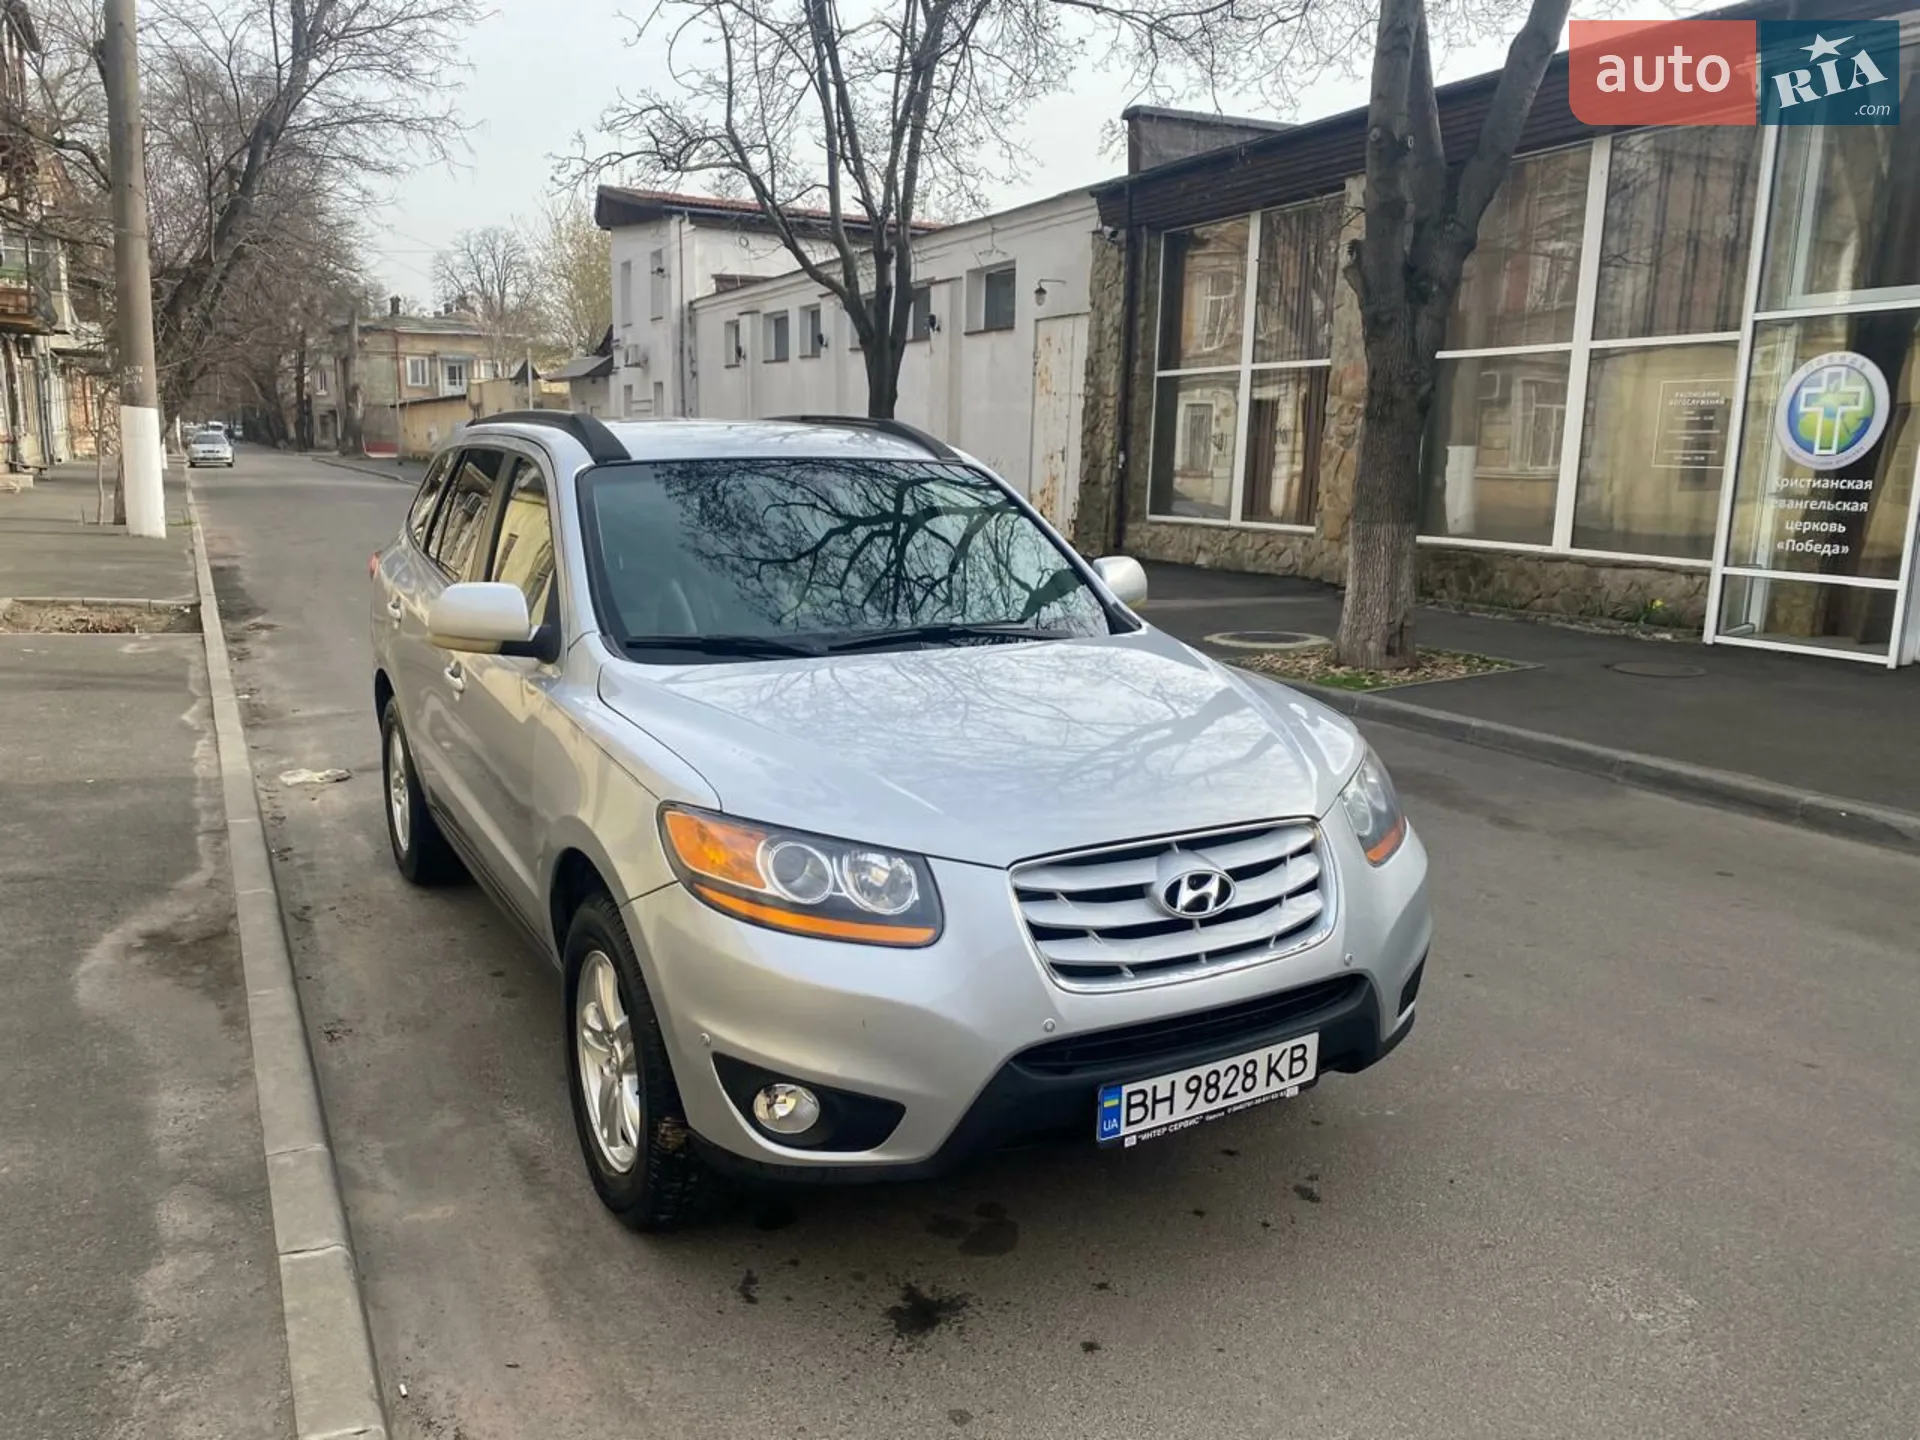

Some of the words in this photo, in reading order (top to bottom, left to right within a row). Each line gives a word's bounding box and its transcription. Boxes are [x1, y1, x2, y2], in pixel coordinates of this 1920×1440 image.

[1785, 520, 1847, 534] церковь
[1777, 538, 1849, 557] «Победа»
[1125, 1080, 1176, 1127] BH
[1185, 1059, 1258, 1111] 9828
[1266, 1043, 1307, 1088] KB
[1103, 1118, 1119, 1131] UA
